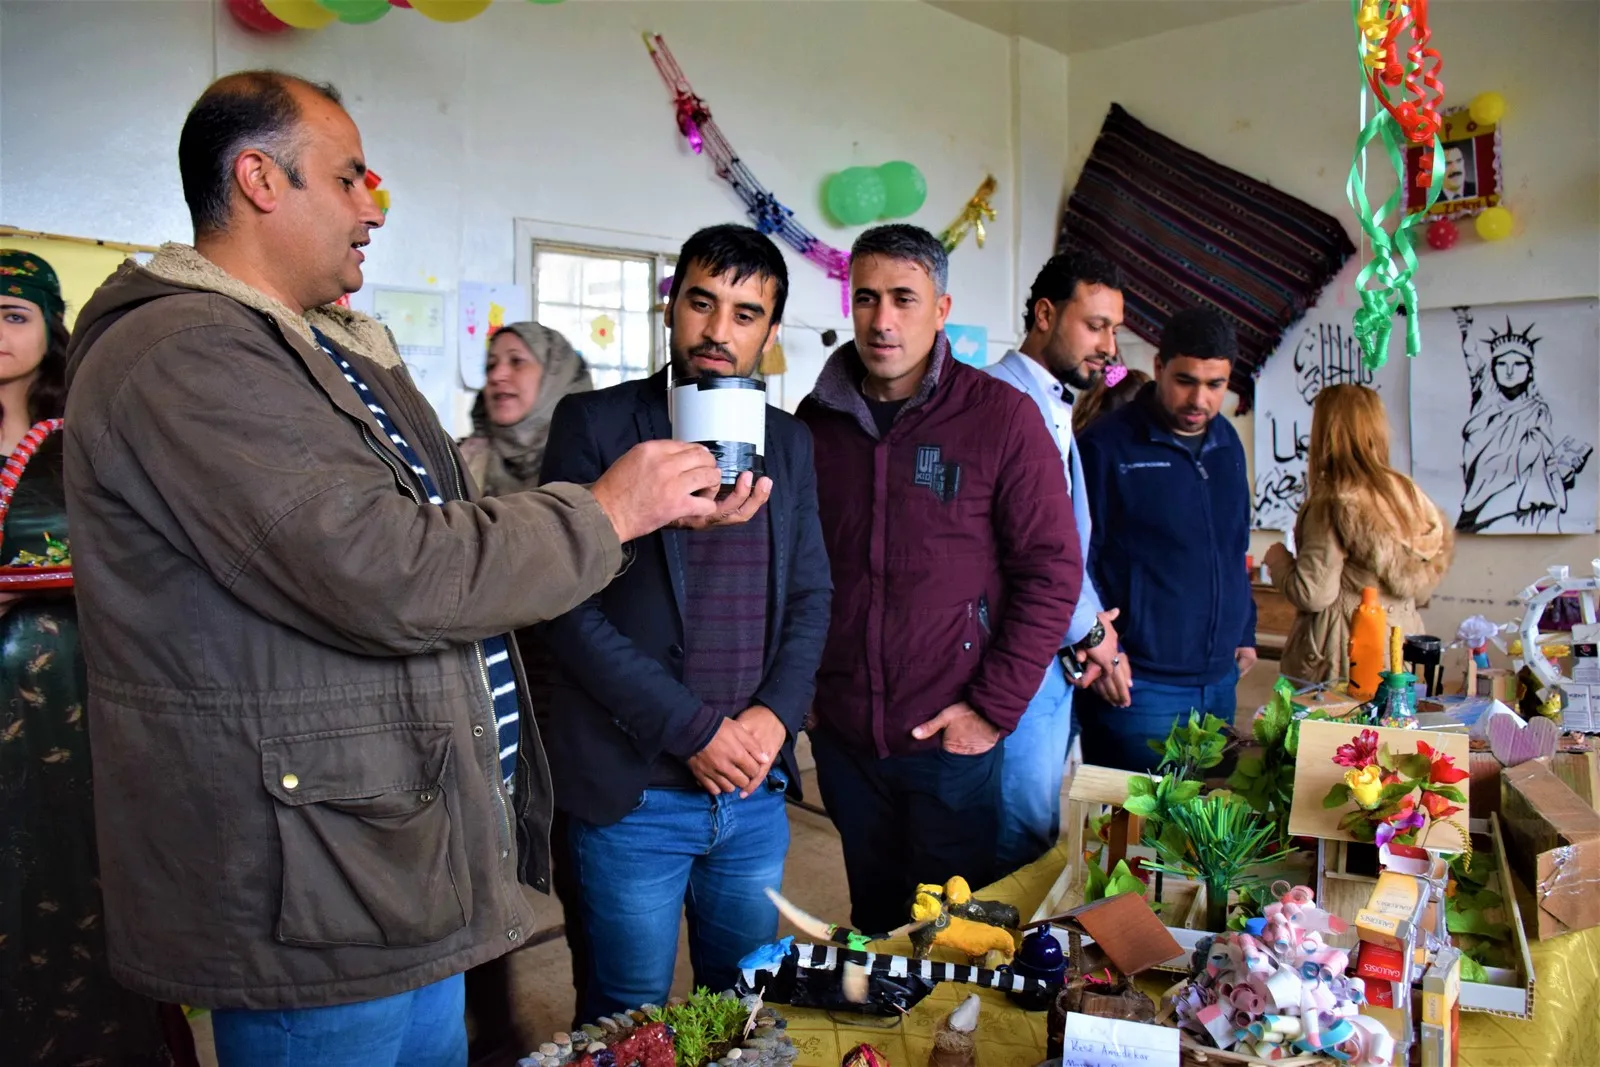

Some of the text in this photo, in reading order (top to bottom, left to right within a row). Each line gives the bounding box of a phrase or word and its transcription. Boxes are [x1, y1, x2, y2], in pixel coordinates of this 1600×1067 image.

[919, 449, 938, 473] UP
[1360, 915, 1395, 929] GAULOISES
[1364, 963, 1400, 978] GAULOISES
